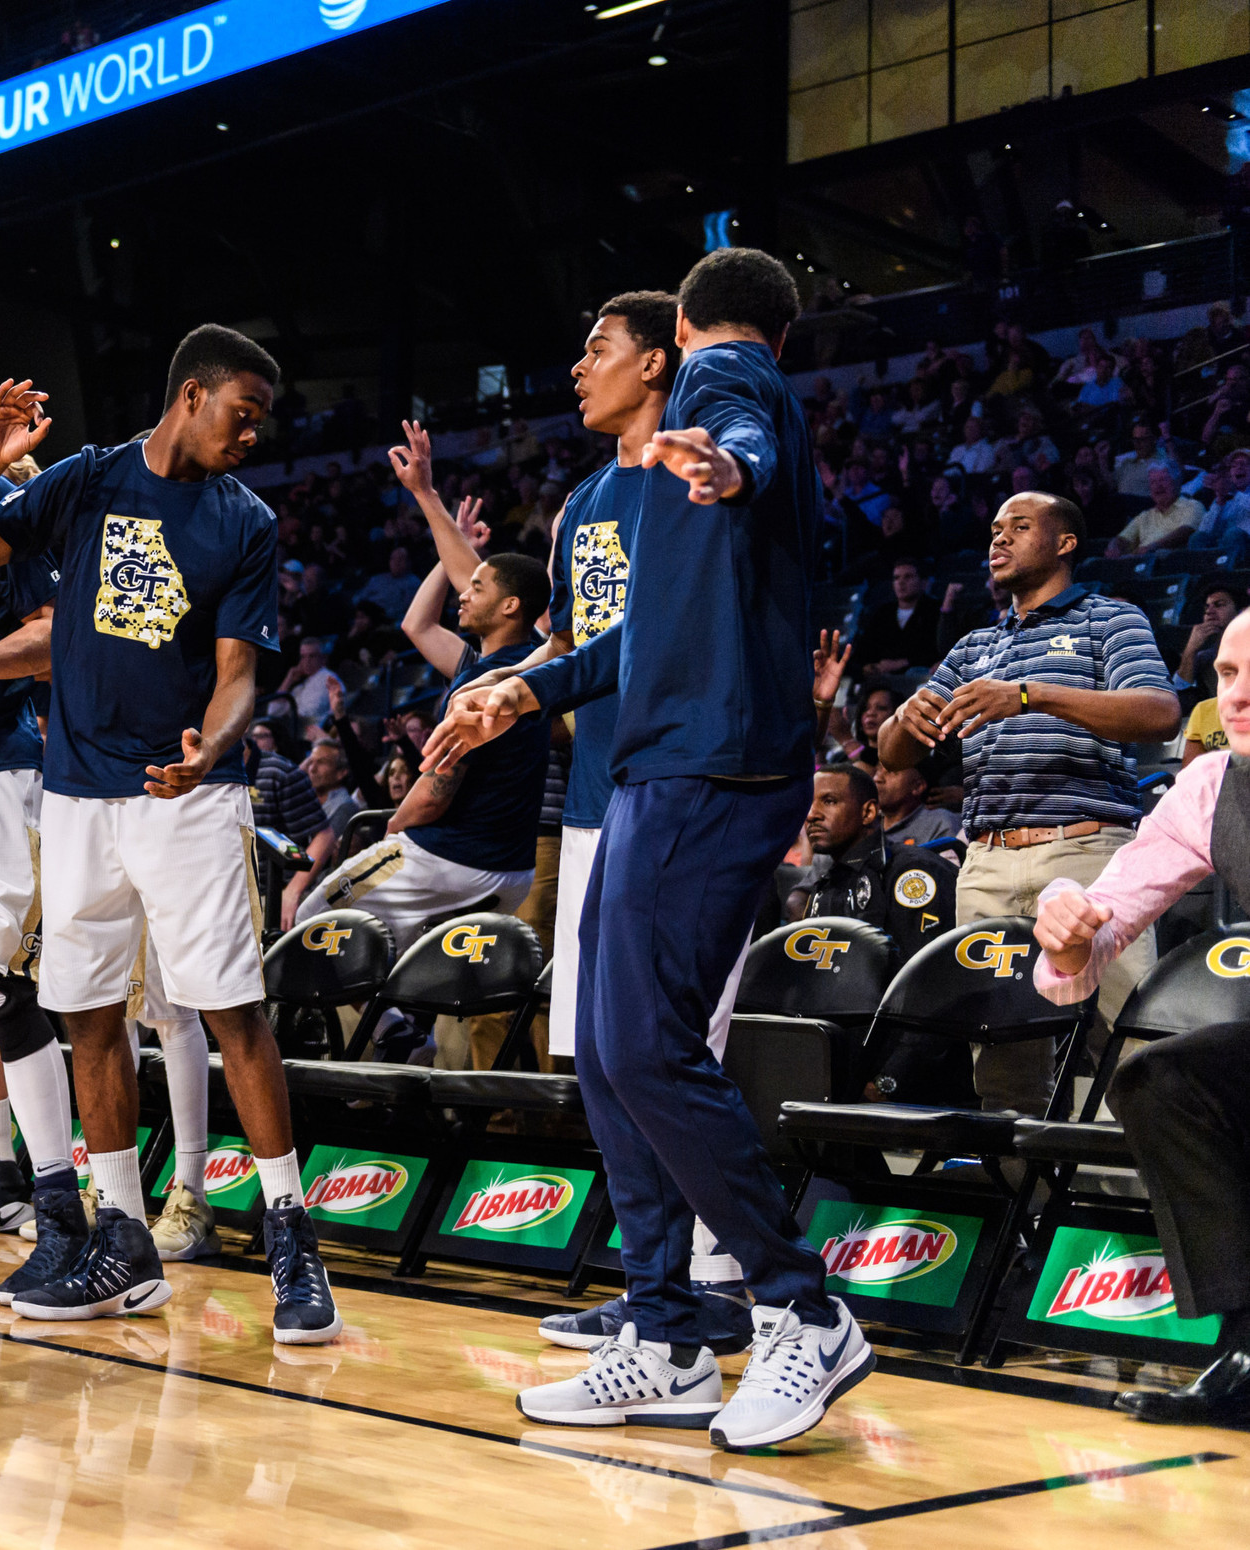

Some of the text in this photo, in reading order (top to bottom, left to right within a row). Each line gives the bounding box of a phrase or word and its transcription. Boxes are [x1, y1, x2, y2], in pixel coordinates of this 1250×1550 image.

[109, 557, 171, 604] GT
[302, 919, 353, 956] GT
[441, 924, 498, 964] GT
[784, 927, 851, 970] GT
[955, 930, 1030, 978] GT
[1205, 936, 1250, 979] G
[303, 1170, 402, 1210] LIBMAN
[451, 1185, 566, 1232] LIBMAN
[820, 1231, 949, 1278] LIBMAN
